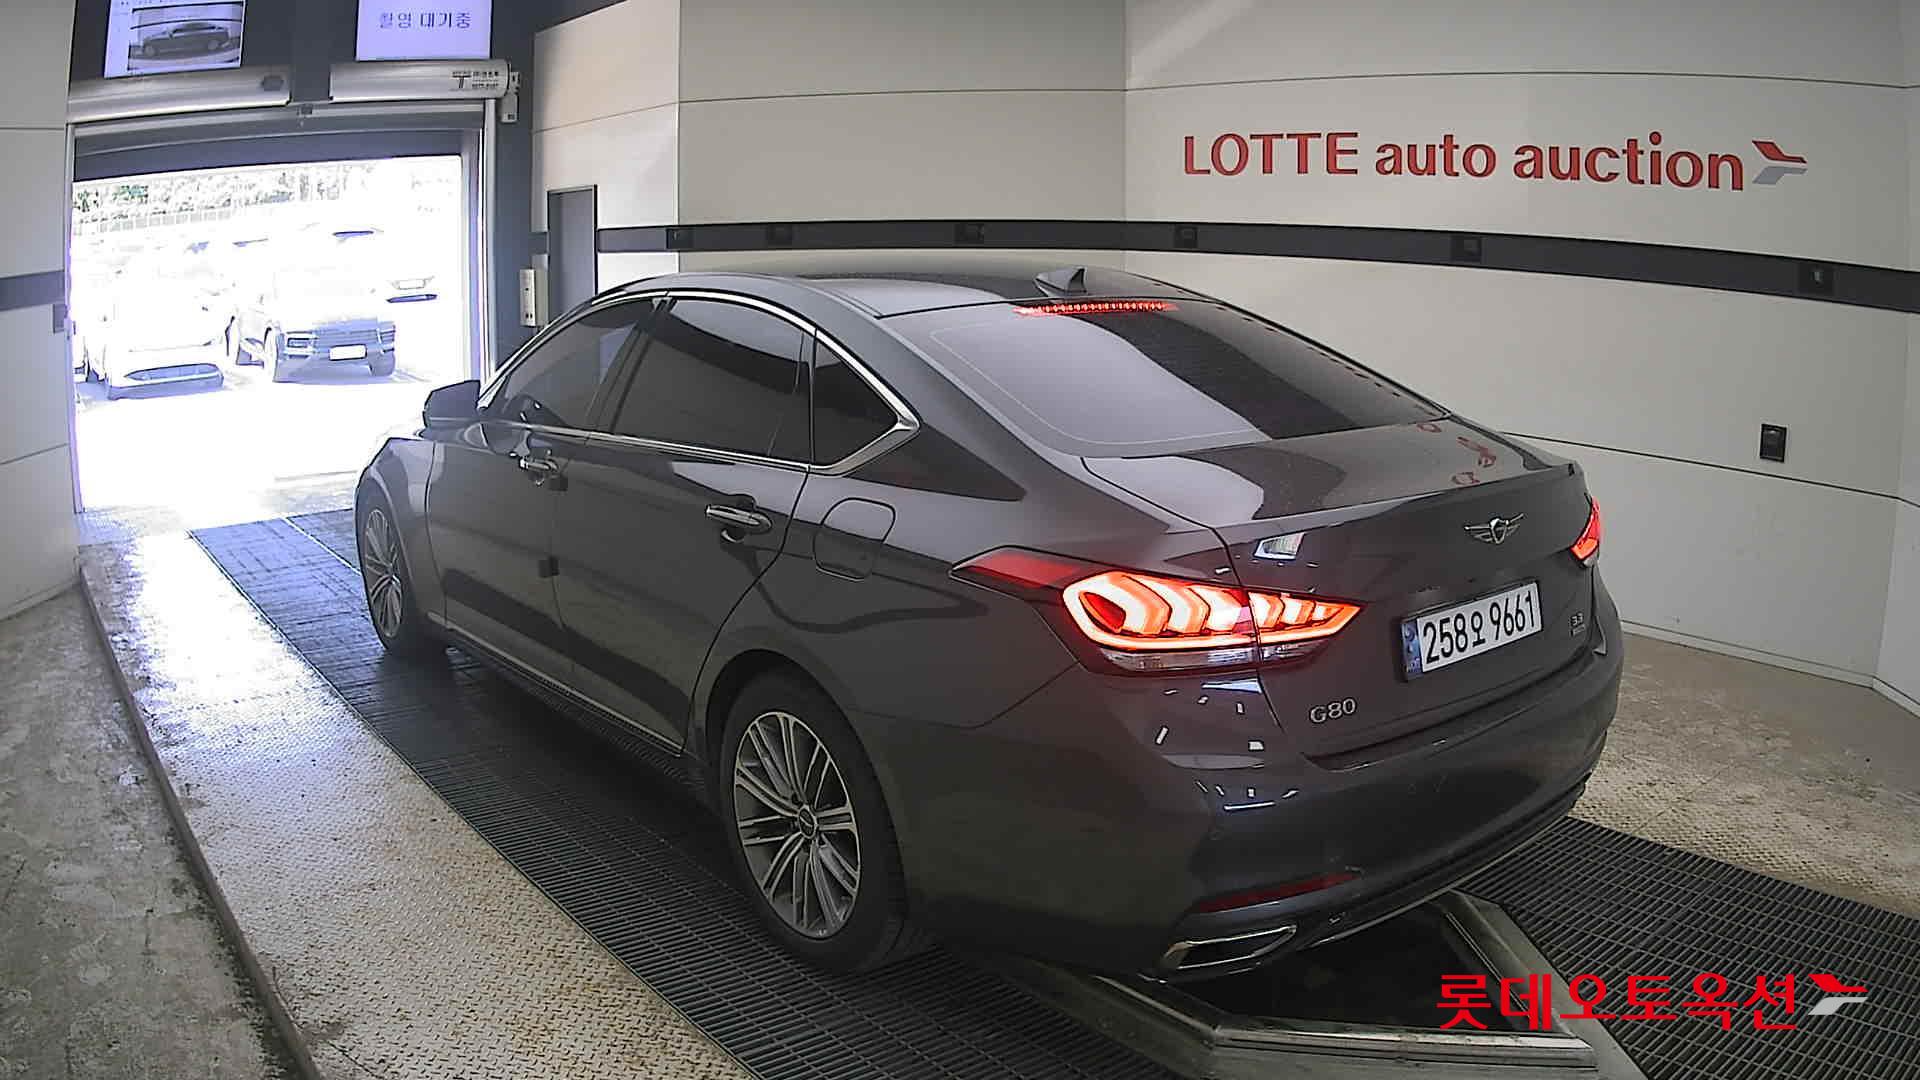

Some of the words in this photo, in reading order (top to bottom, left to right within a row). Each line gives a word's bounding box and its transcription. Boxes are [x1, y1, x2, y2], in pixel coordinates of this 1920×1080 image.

[420, 12, 471, 29] 대기중
[1183, 131, 1359, 176] LOTTE
[1376, 135, 1498, 178] auto
[1513, 131, 1745, 191] auction
[1310, 698, 1356, 723] G80
